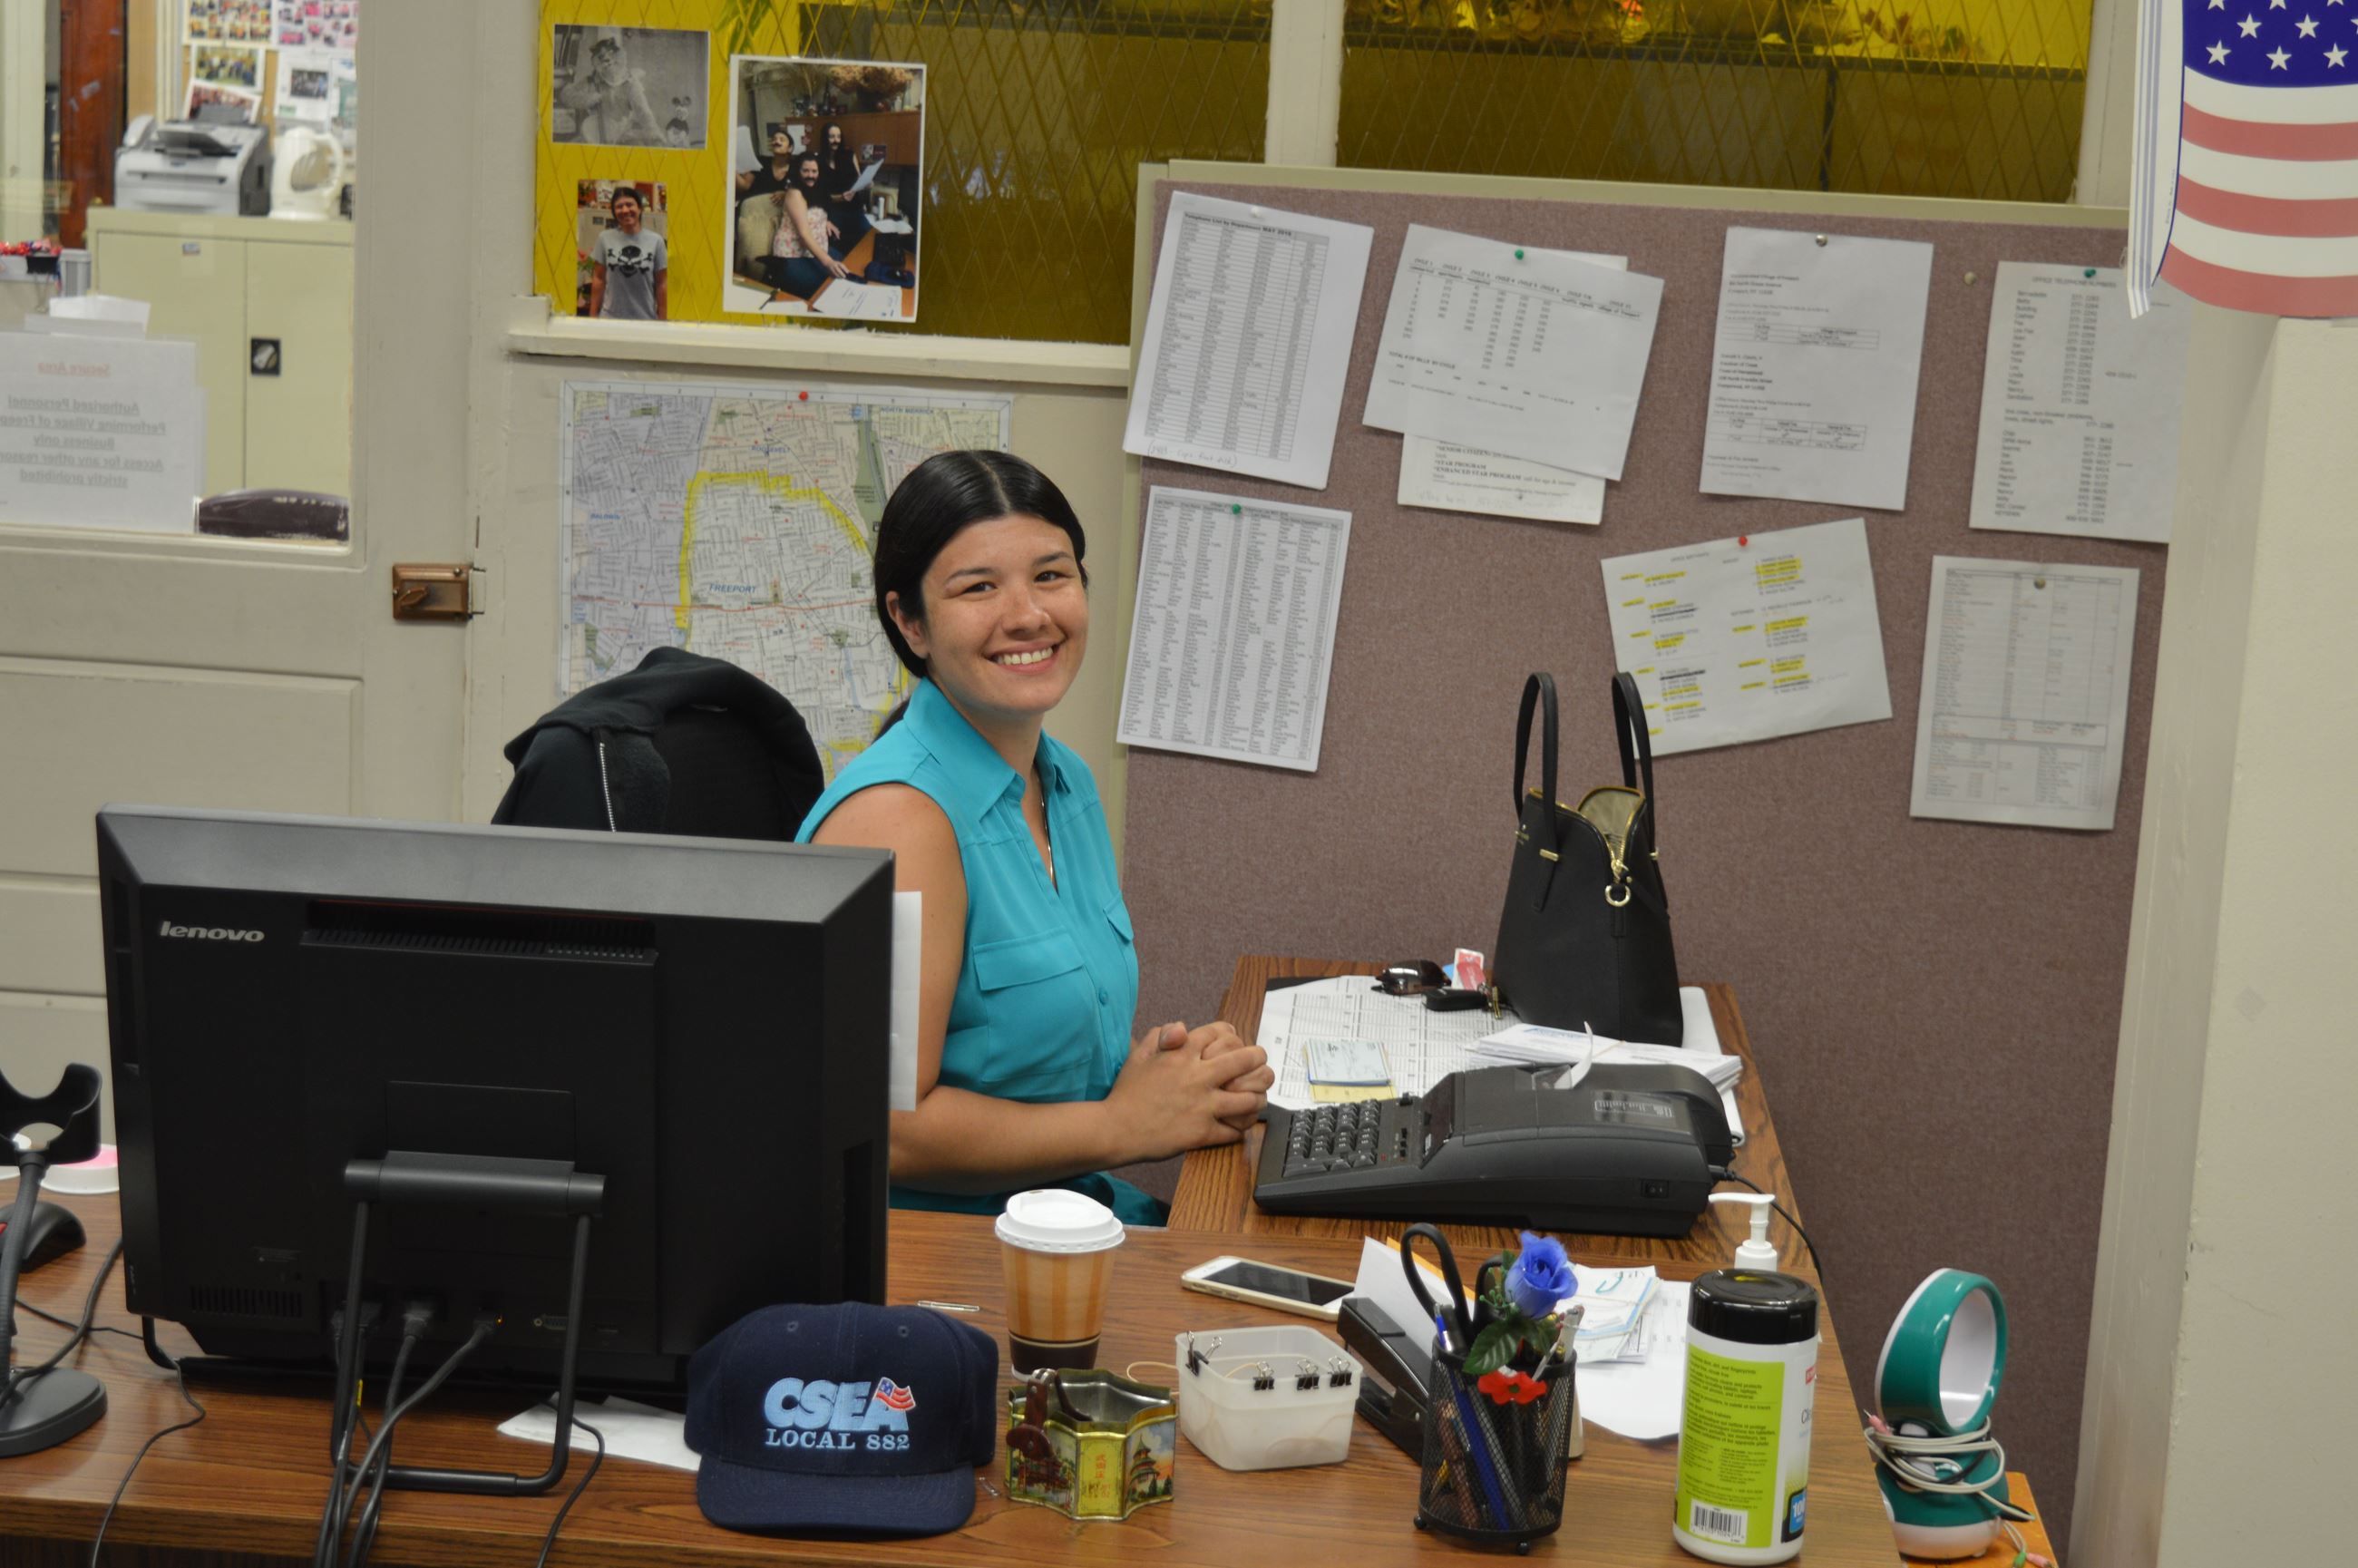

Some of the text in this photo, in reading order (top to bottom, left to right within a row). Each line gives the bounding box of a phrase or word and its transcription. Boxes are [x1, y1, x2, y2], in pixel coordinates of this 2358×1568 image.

[1184, 213, 1211, 222] Telephone
[1231, 221, 1261, 230] Department
[1489, 472, 1521, 481] PROGRAM
[709, 584, 757, 593] FREEPORT
[160, 921, 265, 941] lenovo
[765, 1377, 909, 1431] CSEA
[765, 1428, 910, 1451] LOCAL 882
